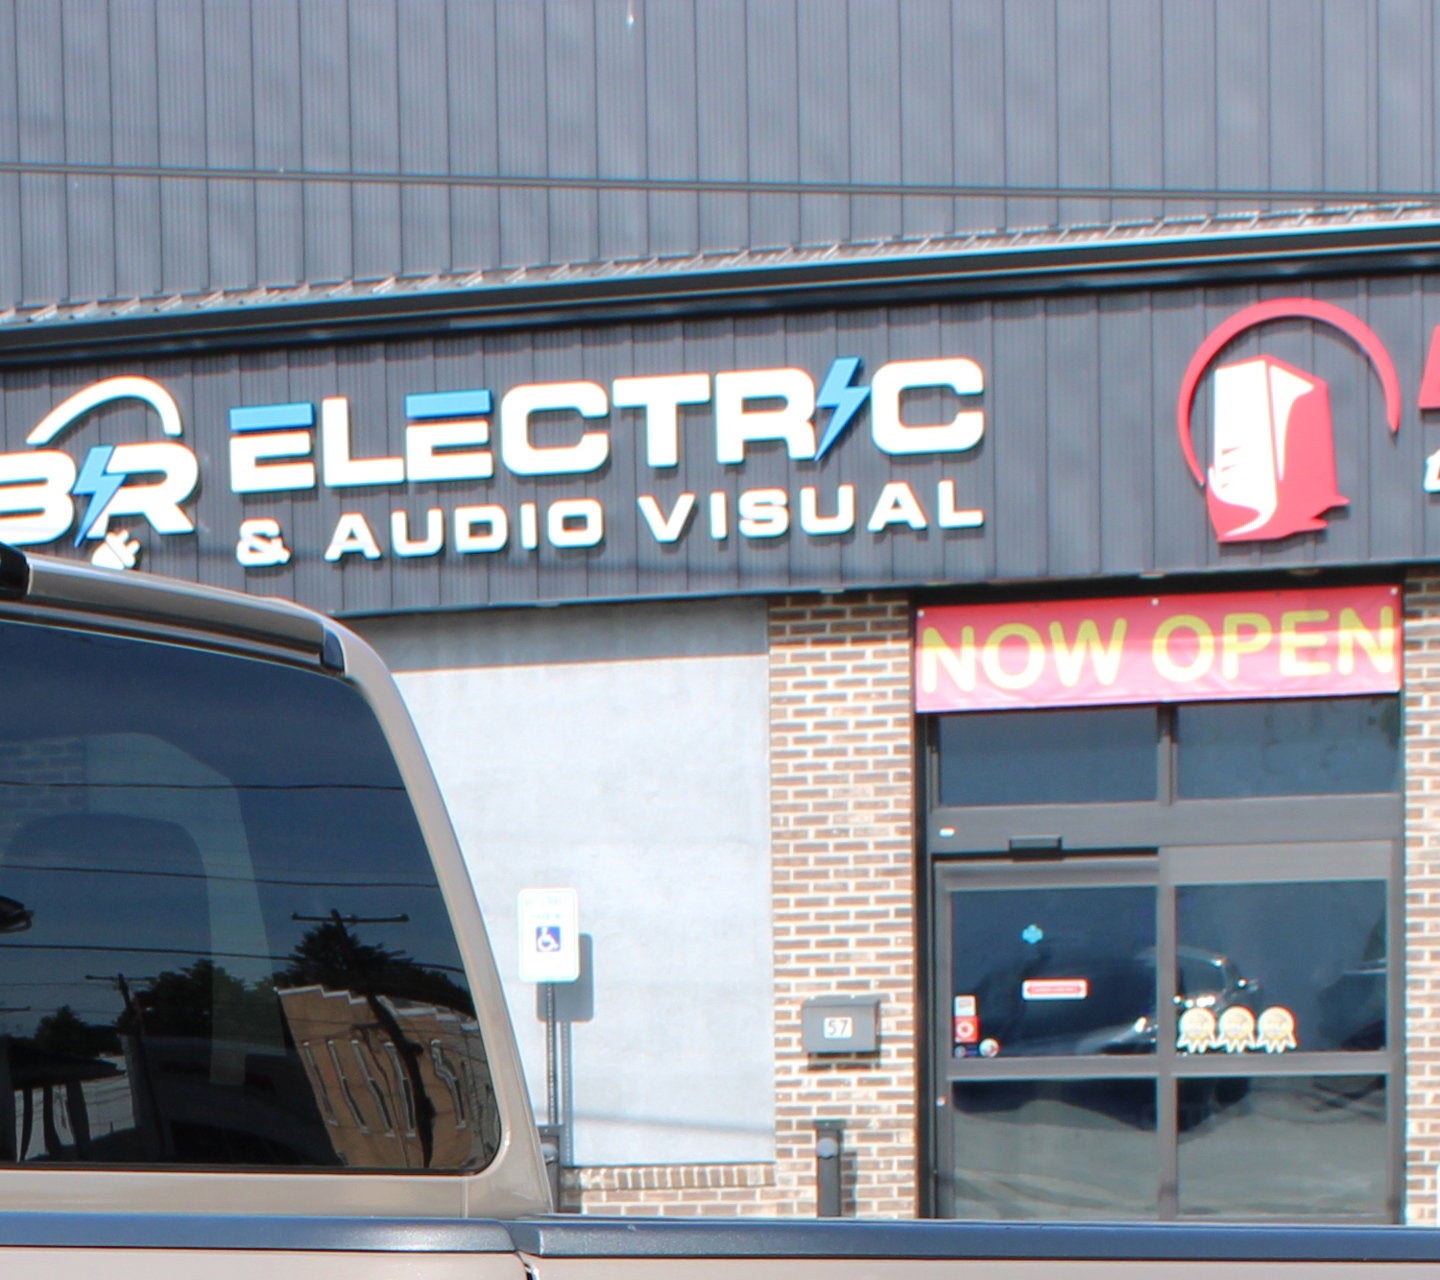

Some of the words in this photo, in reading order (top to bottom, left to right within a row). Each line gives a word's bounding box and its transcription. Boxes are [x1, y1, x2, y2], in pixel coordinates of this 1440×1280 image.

[229, 356, 986, 494] ELECTRIC
[236, 517, 292, 567] &
[325, 495, 606, 562] AUDIO
[639, 480, 986, 543] VISUAL
[921, 615, 1127, 693] NOW
[1150, 605, 1397, 680] OPEN
[828, 1018, 849, 1036] 57
